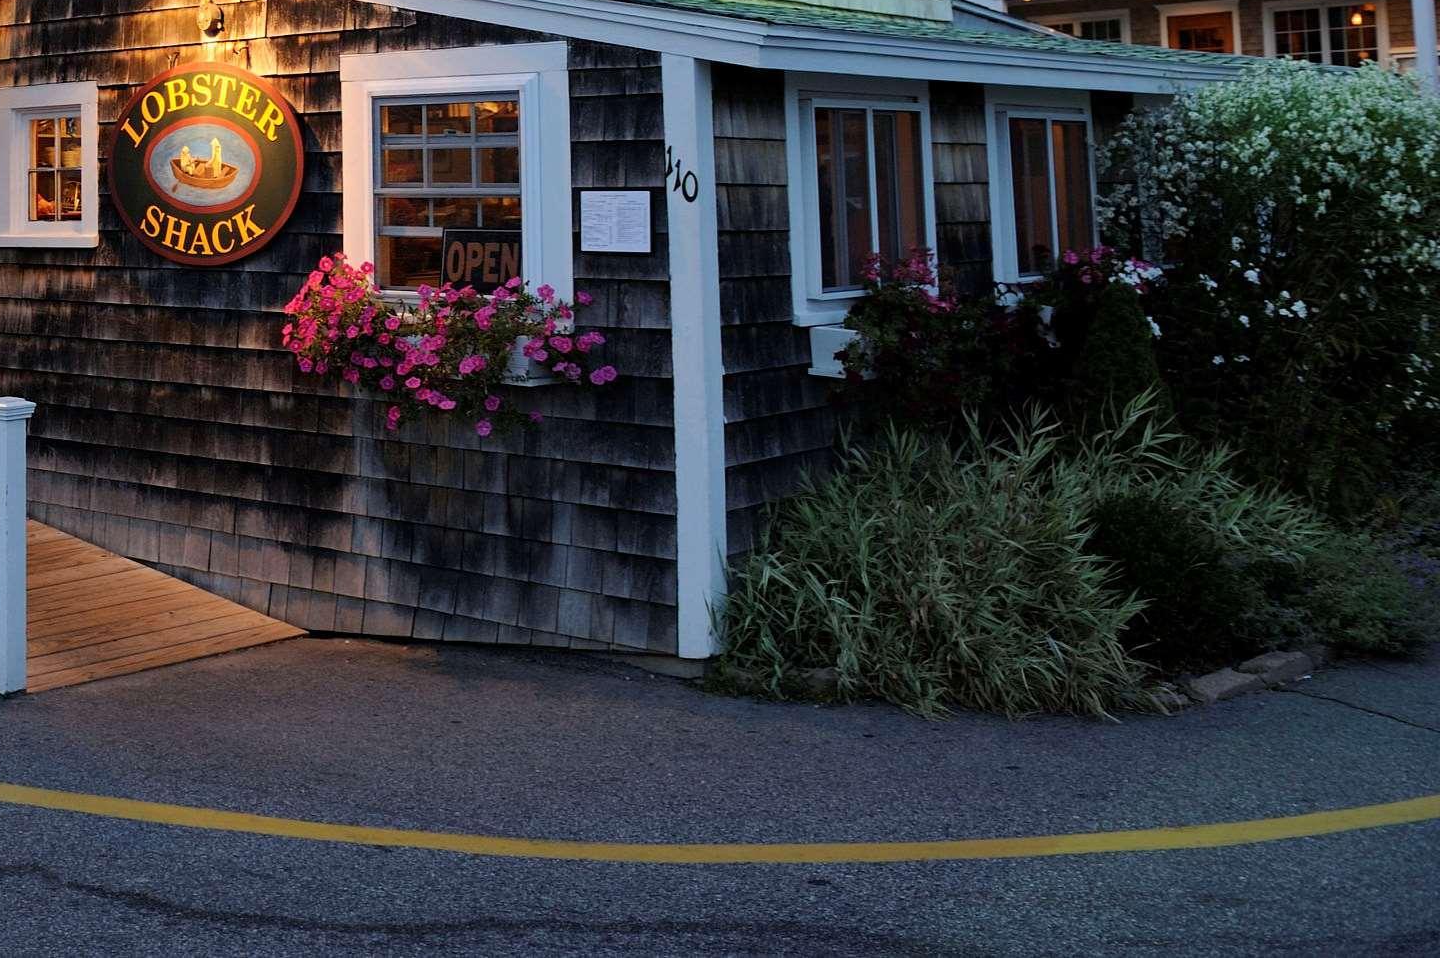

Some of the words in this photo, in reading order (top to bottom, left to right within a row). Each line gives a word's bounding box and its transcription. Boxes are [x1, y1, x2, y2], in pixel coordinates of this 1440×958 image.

[120, 73, 285, 148] LOBSTER
[665, 145, 698, 203] 110
[140, 204, 266, 255] SHACK
[447, 241, 519, 283] OPEN
